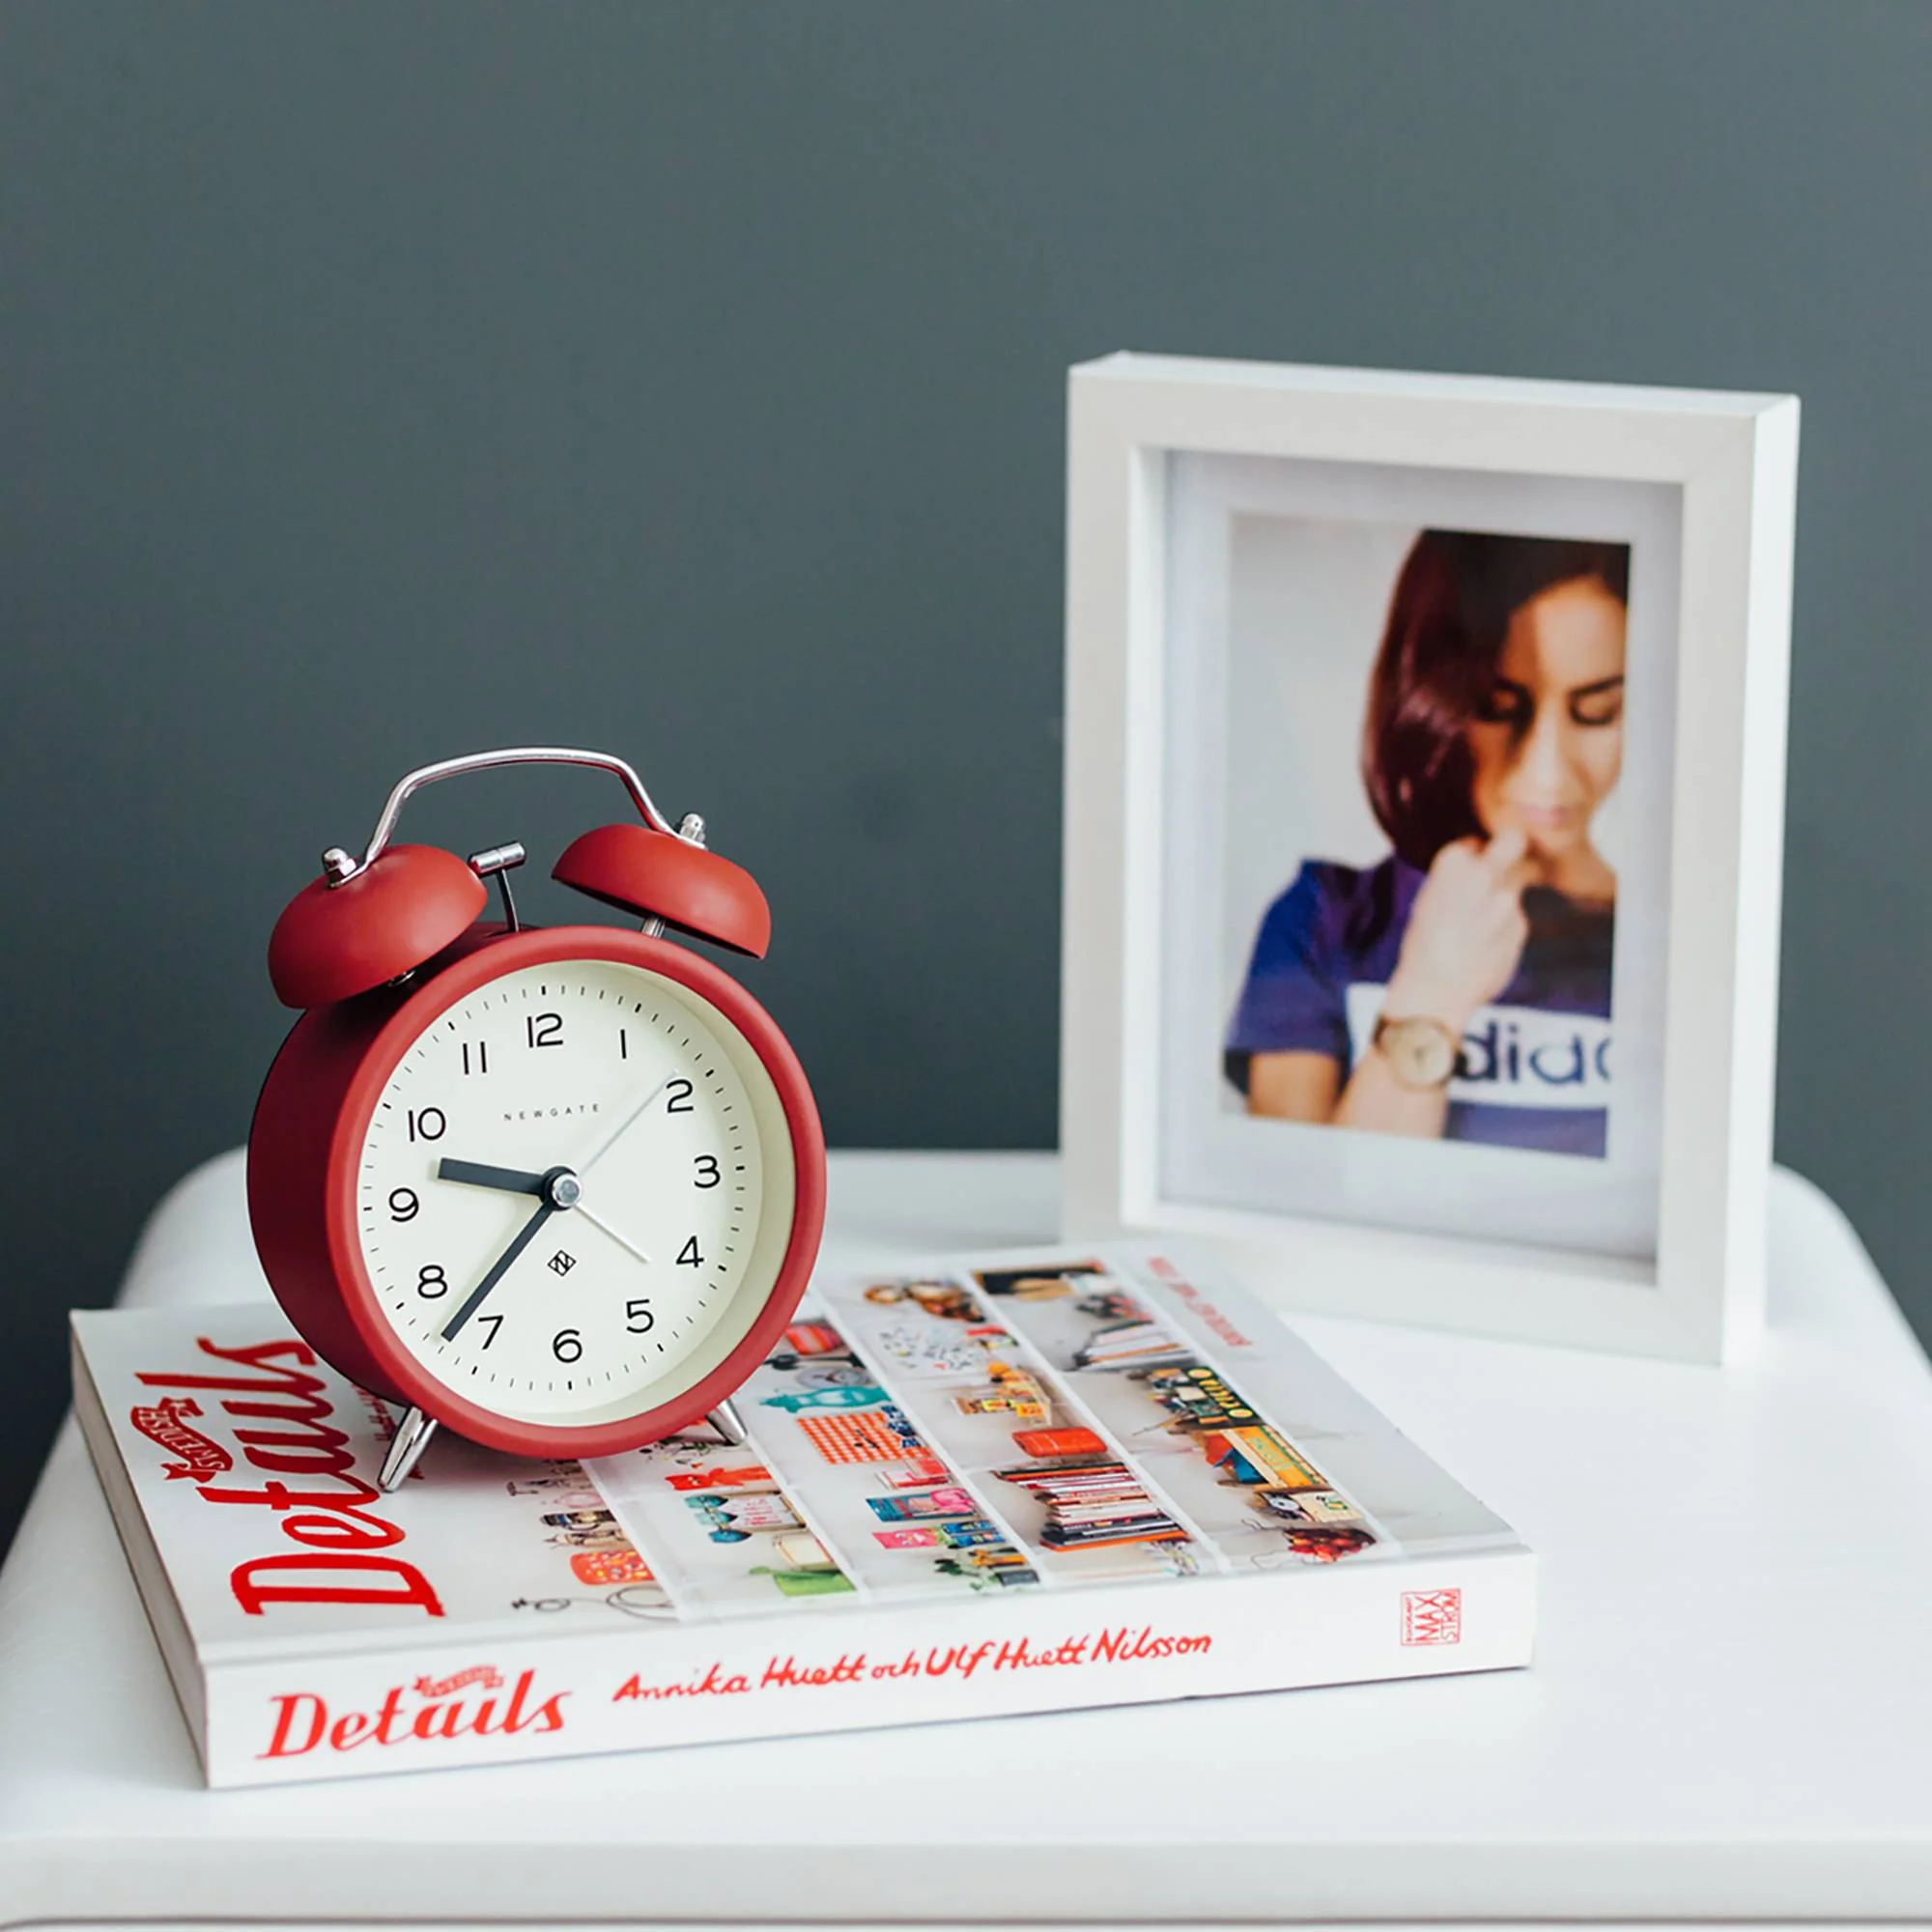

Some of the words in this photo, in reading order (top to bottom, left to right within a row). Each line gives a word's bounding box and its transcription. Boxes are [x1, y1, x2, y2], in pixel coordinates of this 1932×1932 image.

[526, 1012, 563, 1048] 12
[620, 1029, 627, 1060] 1
[463, 1041, 487, 1075] 11
[504, 1103, 599, 1121] NEWGATE
[666, 1079, 694, 1114] 2
[408, 1107, 446, 1142] 10
[694, 1154, 721, 1189] 3
[388, 1187, 419, 1223] 9
[675, 1236, 704, 1268] 4
[417, 1264, 448, 1299] 8
[478, 1315, 504, 1350] 7
[626, 1298, 654, 1334] 5
[553, 1329, 582, 1364] 6
[137, 1408, 225, 1469] SWEDISH
[134, 1337, 446, 1619] Details
[611, 1662, 751, 1702] Annika
[759, 1654, 867, 1690] Huett
[869, 1648, 922, 1680] och
[923, 1639, 996, 1679] Ulf
[992, 1634, 1090, 1671] Huett
[1091, 1625, 1213, 1662] Nilsson
[256, 1667, 572, 1760] Details
